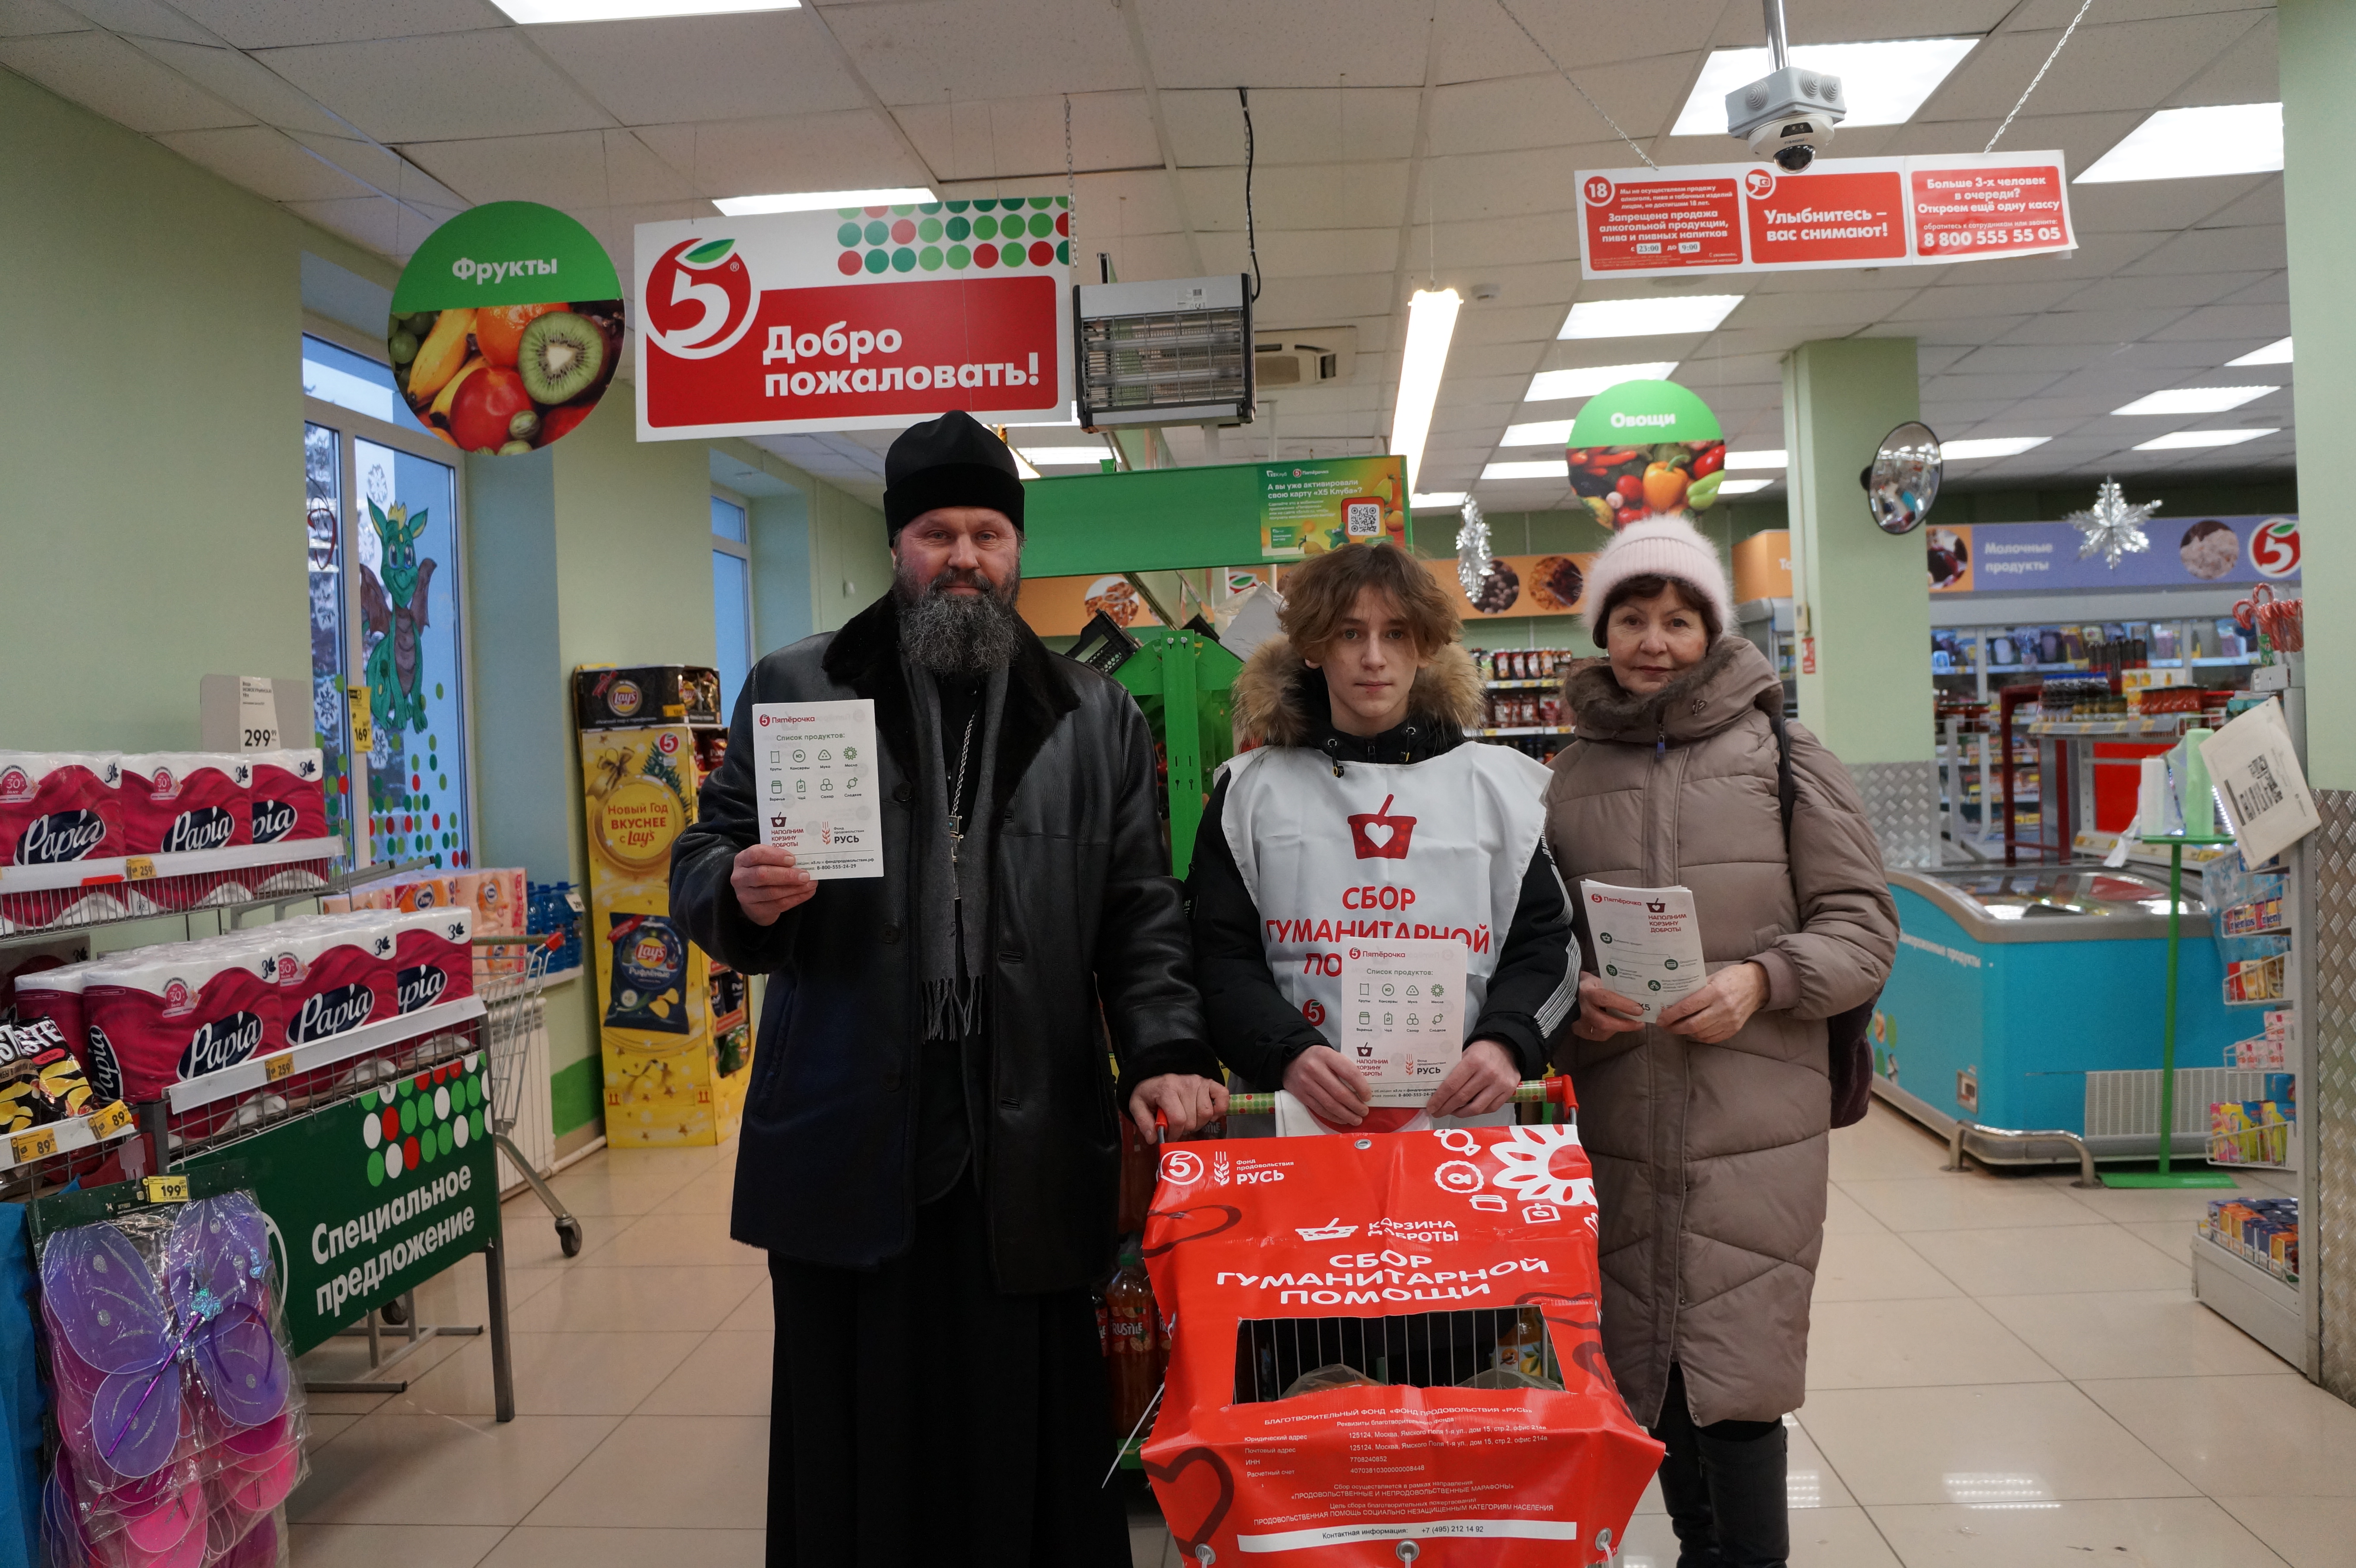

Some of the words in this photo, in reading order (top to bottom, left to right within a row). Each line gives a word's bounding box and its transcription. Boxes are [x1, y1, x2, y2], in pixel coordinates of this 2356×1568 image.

[1589, 183, 1608, 198] 18
[1927, 178, 1973, 189] Больше
[1975, 177, 1995, 187] 3-х
[1997, 177, 2046, 186] человек
[1964, 187, 2021, 202] очереди?
[1764, 207, 1872, 224] Улыбнитесь
[1918, 203, 1969, 215] Откроем
[1970, 201, 1995, 213] ещё
[1997, 201, 2026, 213] одну
[2028, 201, 2060, 211] кассу
[1609, 213, 1669, 223] Запрещена
[1671, 211, 1718, 222] продажа
[1599, 221, 1666, 232] алкогольной
[1668, 219, 1729, 231] продукции,
[1767, 229, 1797, 242] вас
[1801, 222, 1888, 240] снимают!
[1602, 234, 1627, 243] пива
[1638, 232, 1677, 241] пивных
[1680, 230, 1728, 240] напитков
[1924, 232, 1935, 247] 8
[1939, 231, 1972, 247] 800
[1976, 230, 2008, 245] 555
[2013, 228, 2034, 243] 55
[2038, 227, 2062, 240] 05
[453, 256, 557, 284] Фрукты
[764, 321, 902, 366] Добро
[765, 352, 1039, 397] пожаловать!
[1610, 412, 1676, 427] Овощи
[1303, 480, 1358, 488] активировали
[1330, 487, 1362, 495] Клуба»?
[1985, 541, 2052, 556] Молочные
[1985, 560, 2049, 574] продукты
[772, 715, 815, 724] Пятёрочка
[244, 729, 271, 747] 299
[355, 727, 367, 742] 169
[804, 732, 846, 741] продуктов:
[6, 779, 20, 789] 30
[608, 803, 646, 815] Новый
[650, 802, 668, 815] Год
[170, 806, 231, 852] Papia
[611, 817, 667, 830] ВКУСНЕЕ
[24, 808, 103, 866] Papia
[627, 829, 655, 847] Lay's
[834, 835, 860, 844] РУСЬ
[139, 866, 153, 876] 259
[1342, 886, 1416, 911] СБОР
[1604, 896, 1641, 906] Пятёрочка
[1266, 919, 1489, 955] ГУМАНИТАРНОЙ
[1362, 950, 1406, 959] Пятёрочка
[170, 991, 181, 1002] 30
[297, 983, 370, 1045] Papia
[187, 1010, 258, 1079] Papia
[277, 1065, 291, 1076] 259
[1417, 1067, 1441, 1075] РУСЬ
[111, 1111, 125, 1126] 89
[37, 1139, 51, 1154] 89
[1236, 1161, 1294, 1171] продовольствия
[1237, 1170, 1285, 1185] РУСЬ
[161, 1184, 181, 1197] 199
[312, 1165, 471, 1264] Специальное
[1368, 1217, 1456, 1230] КОРЗИНА
[317, 1206, 475, 1317] предложение
[1329, 1249, 1432, 1268] СБОР
[1216, 1258, 1549, 1290] ГУМАНИТАРНОЙ
[1280, 1283, 1491, 1305] ПОМОЩИ
[1264, 1409, 1359, 1425] БЛАГОТВОРИТЕЛЬНЫЙ
[1390, 1408, 1419, 1416] «ФОНД
[1420, 1407, 1500, 1417] ПРОДОВОЛЬСТВИЯ
[1244, 1435, 1288, 1443] Юридический
[1402, 1441, 1427, 1449] Ямского
[1247, 1470, 1280, 1478] Расчетный
[1350, 1465, 1425, 1473] 40703810300000008448
[1291, 1491, 1374, 1500] «ПРОДОВОЛЬСТВЕННЫЕ
[1381, 1486, 1469, 1497] НЕПРОДОВОЛЬСТВЕННЫЕ
[1471, 1483, 1514, 1492] МАРАФОНЫ»
[1429, 1497, 1476, 1506] пожертвований
[1254, 1511, 1328, 1526] ПРОДОВОЛЬСТВЕННАЯ
[1407, 1505, 1467, 1515] НЕЗАЩИЩЕННЫМ
[1322, 1530, 1360, 1540] Контактная
[1362, 1527, 1409, 1536] информация:
[1432, 1525, 1450, 1534] (495)
